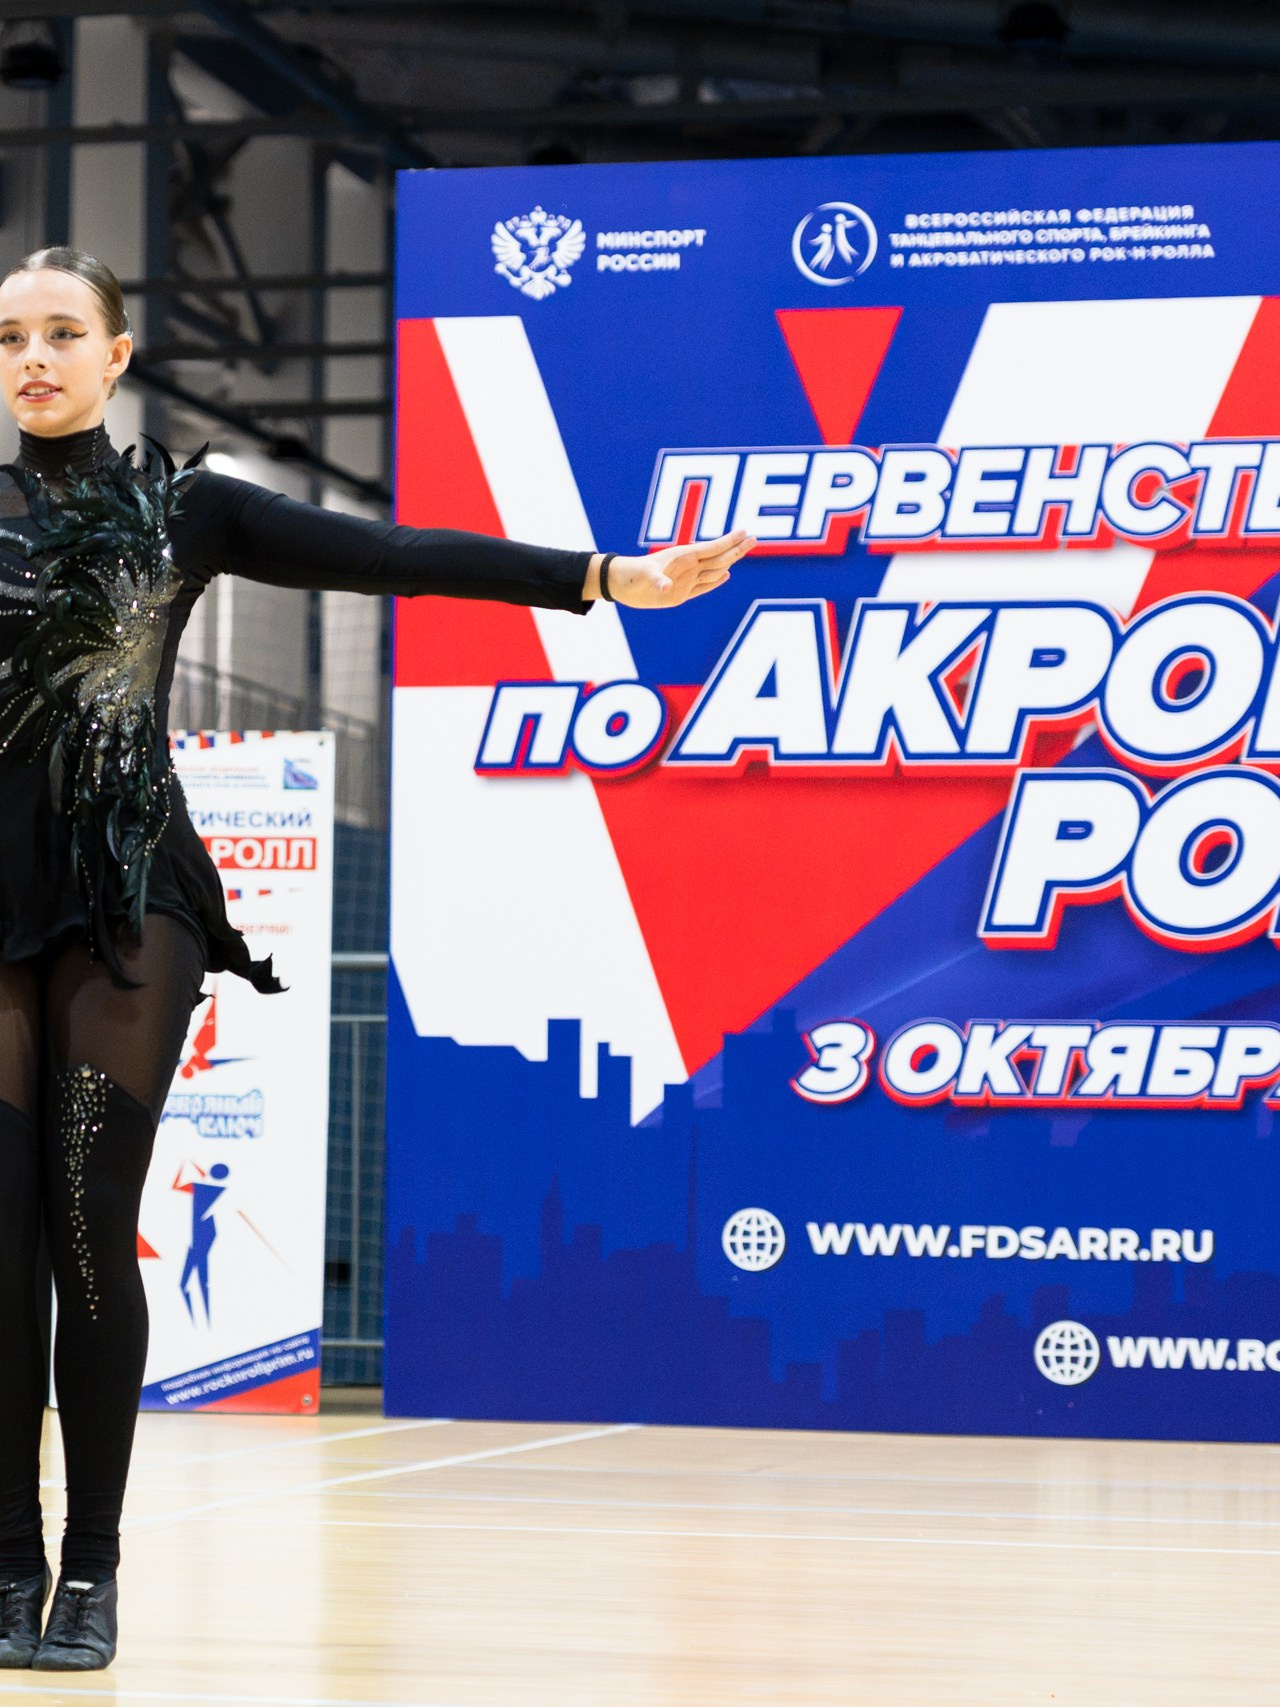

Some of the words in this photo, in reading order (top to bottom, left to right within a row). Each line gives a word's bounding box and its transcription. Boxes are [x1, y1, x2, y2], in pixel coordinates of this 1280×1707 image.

[904, 209, 1071, 229] ВСЕРОССИЙСКАЯ
[1075, 205, 1194, 224] ФЕДЕРАЦИЯ
[597, 229, 707, 250] МИНСПОРТ
[888, 229, 1034, 248] ТАНЦЕВАЛЬНОГО
[1035, 227, 1107, 244] СПОРТА,
[1109, 223, 1211, 242] БРЕЙКИНГА
[597, 252, 680, 272] РОССИИ
[890, 253, 905, 268] И
[907, 248, 1085, 267] АКРОБАТИЧЕСКОГО
[666, 594, 1280, 772] АКРО
[981, 766, 1280, 944] РО
[793, 1019, 873, 1101] 3
[881, 1018, 1280, 1106] ОКТЯБР
[806, 1222, 1214, 1262] WWW.FDSARR.RU
